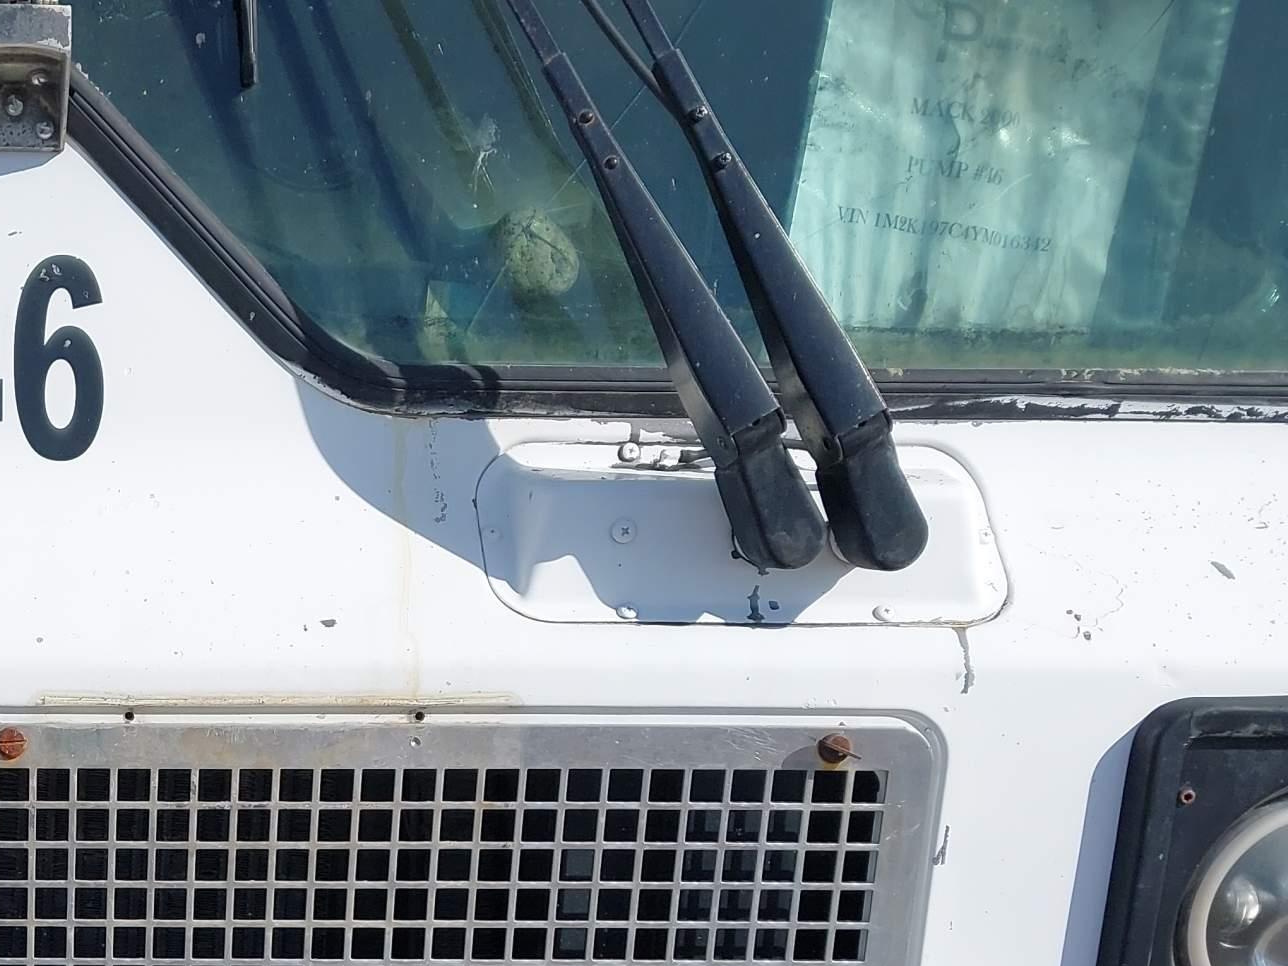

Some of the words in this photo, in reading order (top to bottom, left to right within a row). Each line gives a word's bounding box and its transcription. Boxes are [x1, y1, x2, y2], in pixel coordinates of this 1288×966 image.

[910, 98, 975, 122] MACK
[907, 156, 969, 179] PUMP
[838, 206, 868, 224] VIN
